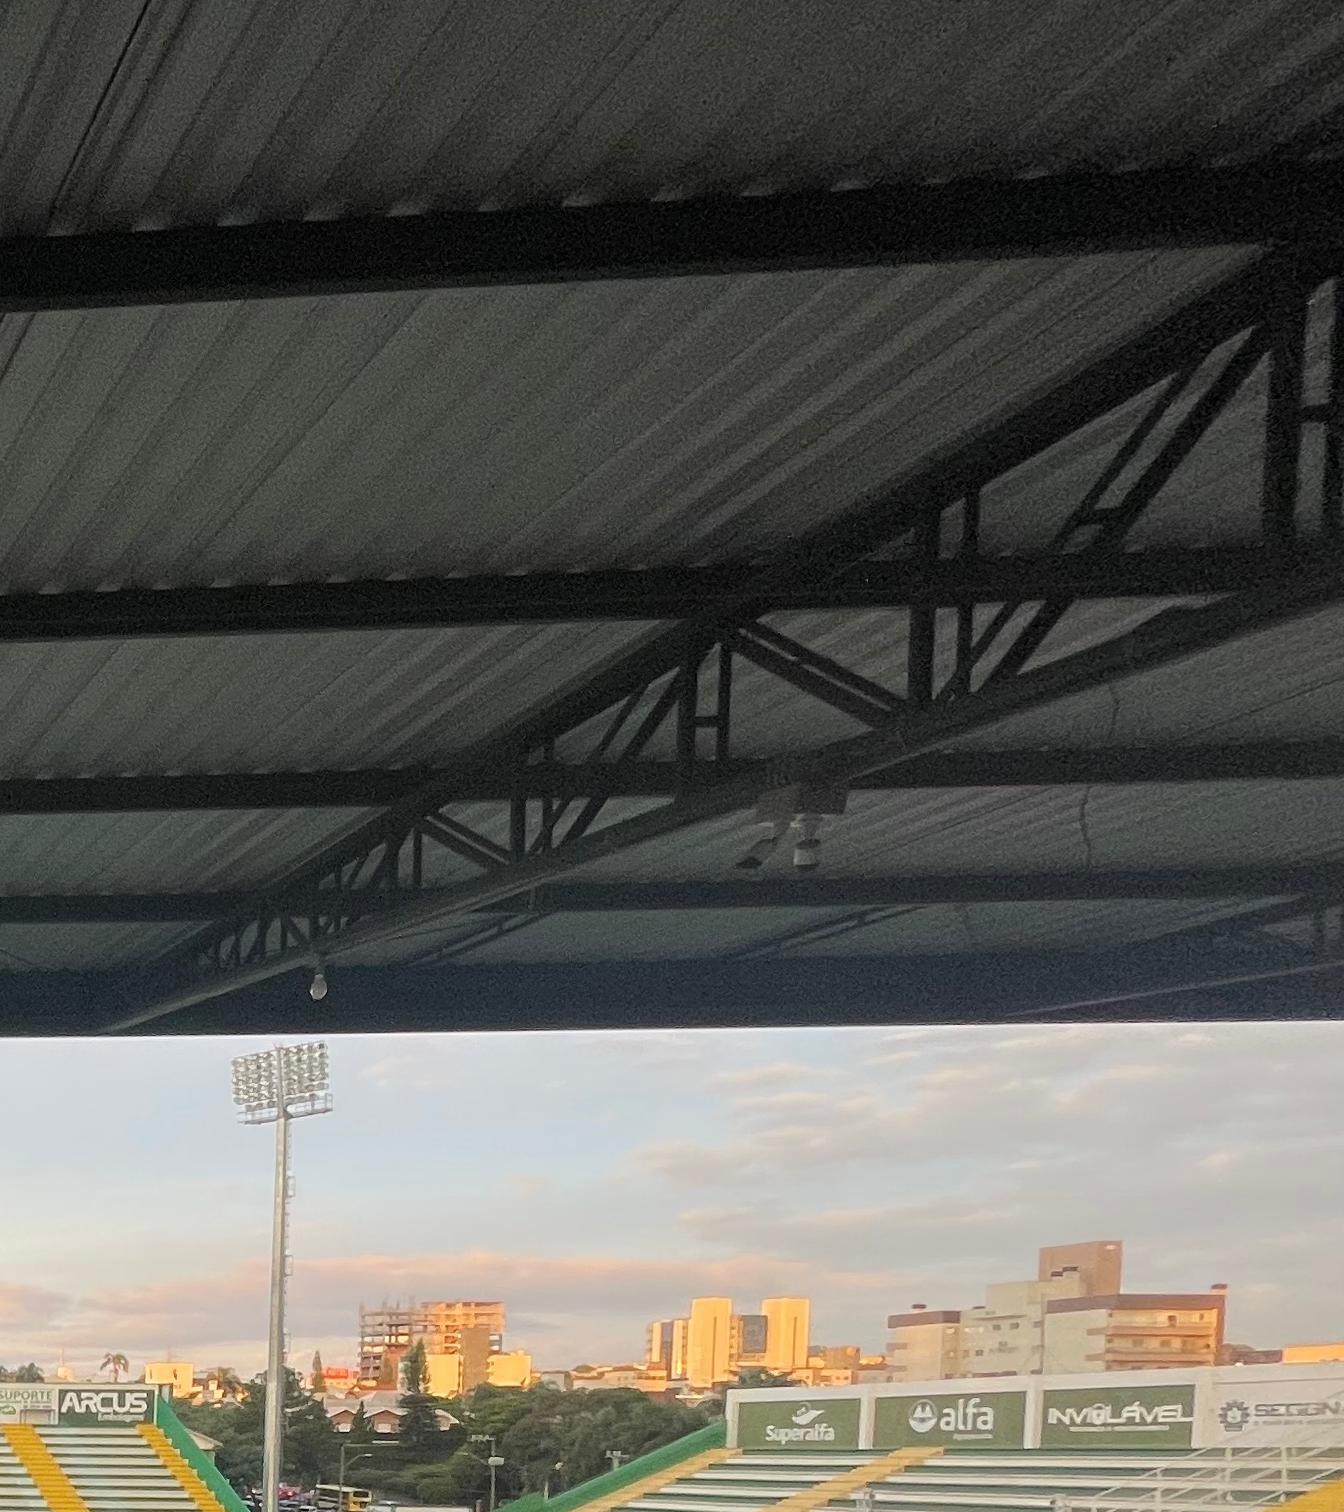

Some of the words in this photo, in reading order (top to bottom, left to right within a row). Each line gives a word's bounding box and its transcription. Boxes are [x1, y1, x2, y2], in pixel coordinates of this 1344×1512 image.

[61, 1392, 147, 1413] ARCUS
[940, 1398, 993, 1430] alfa
[765, 1423, 835, 1444] Superalfa
